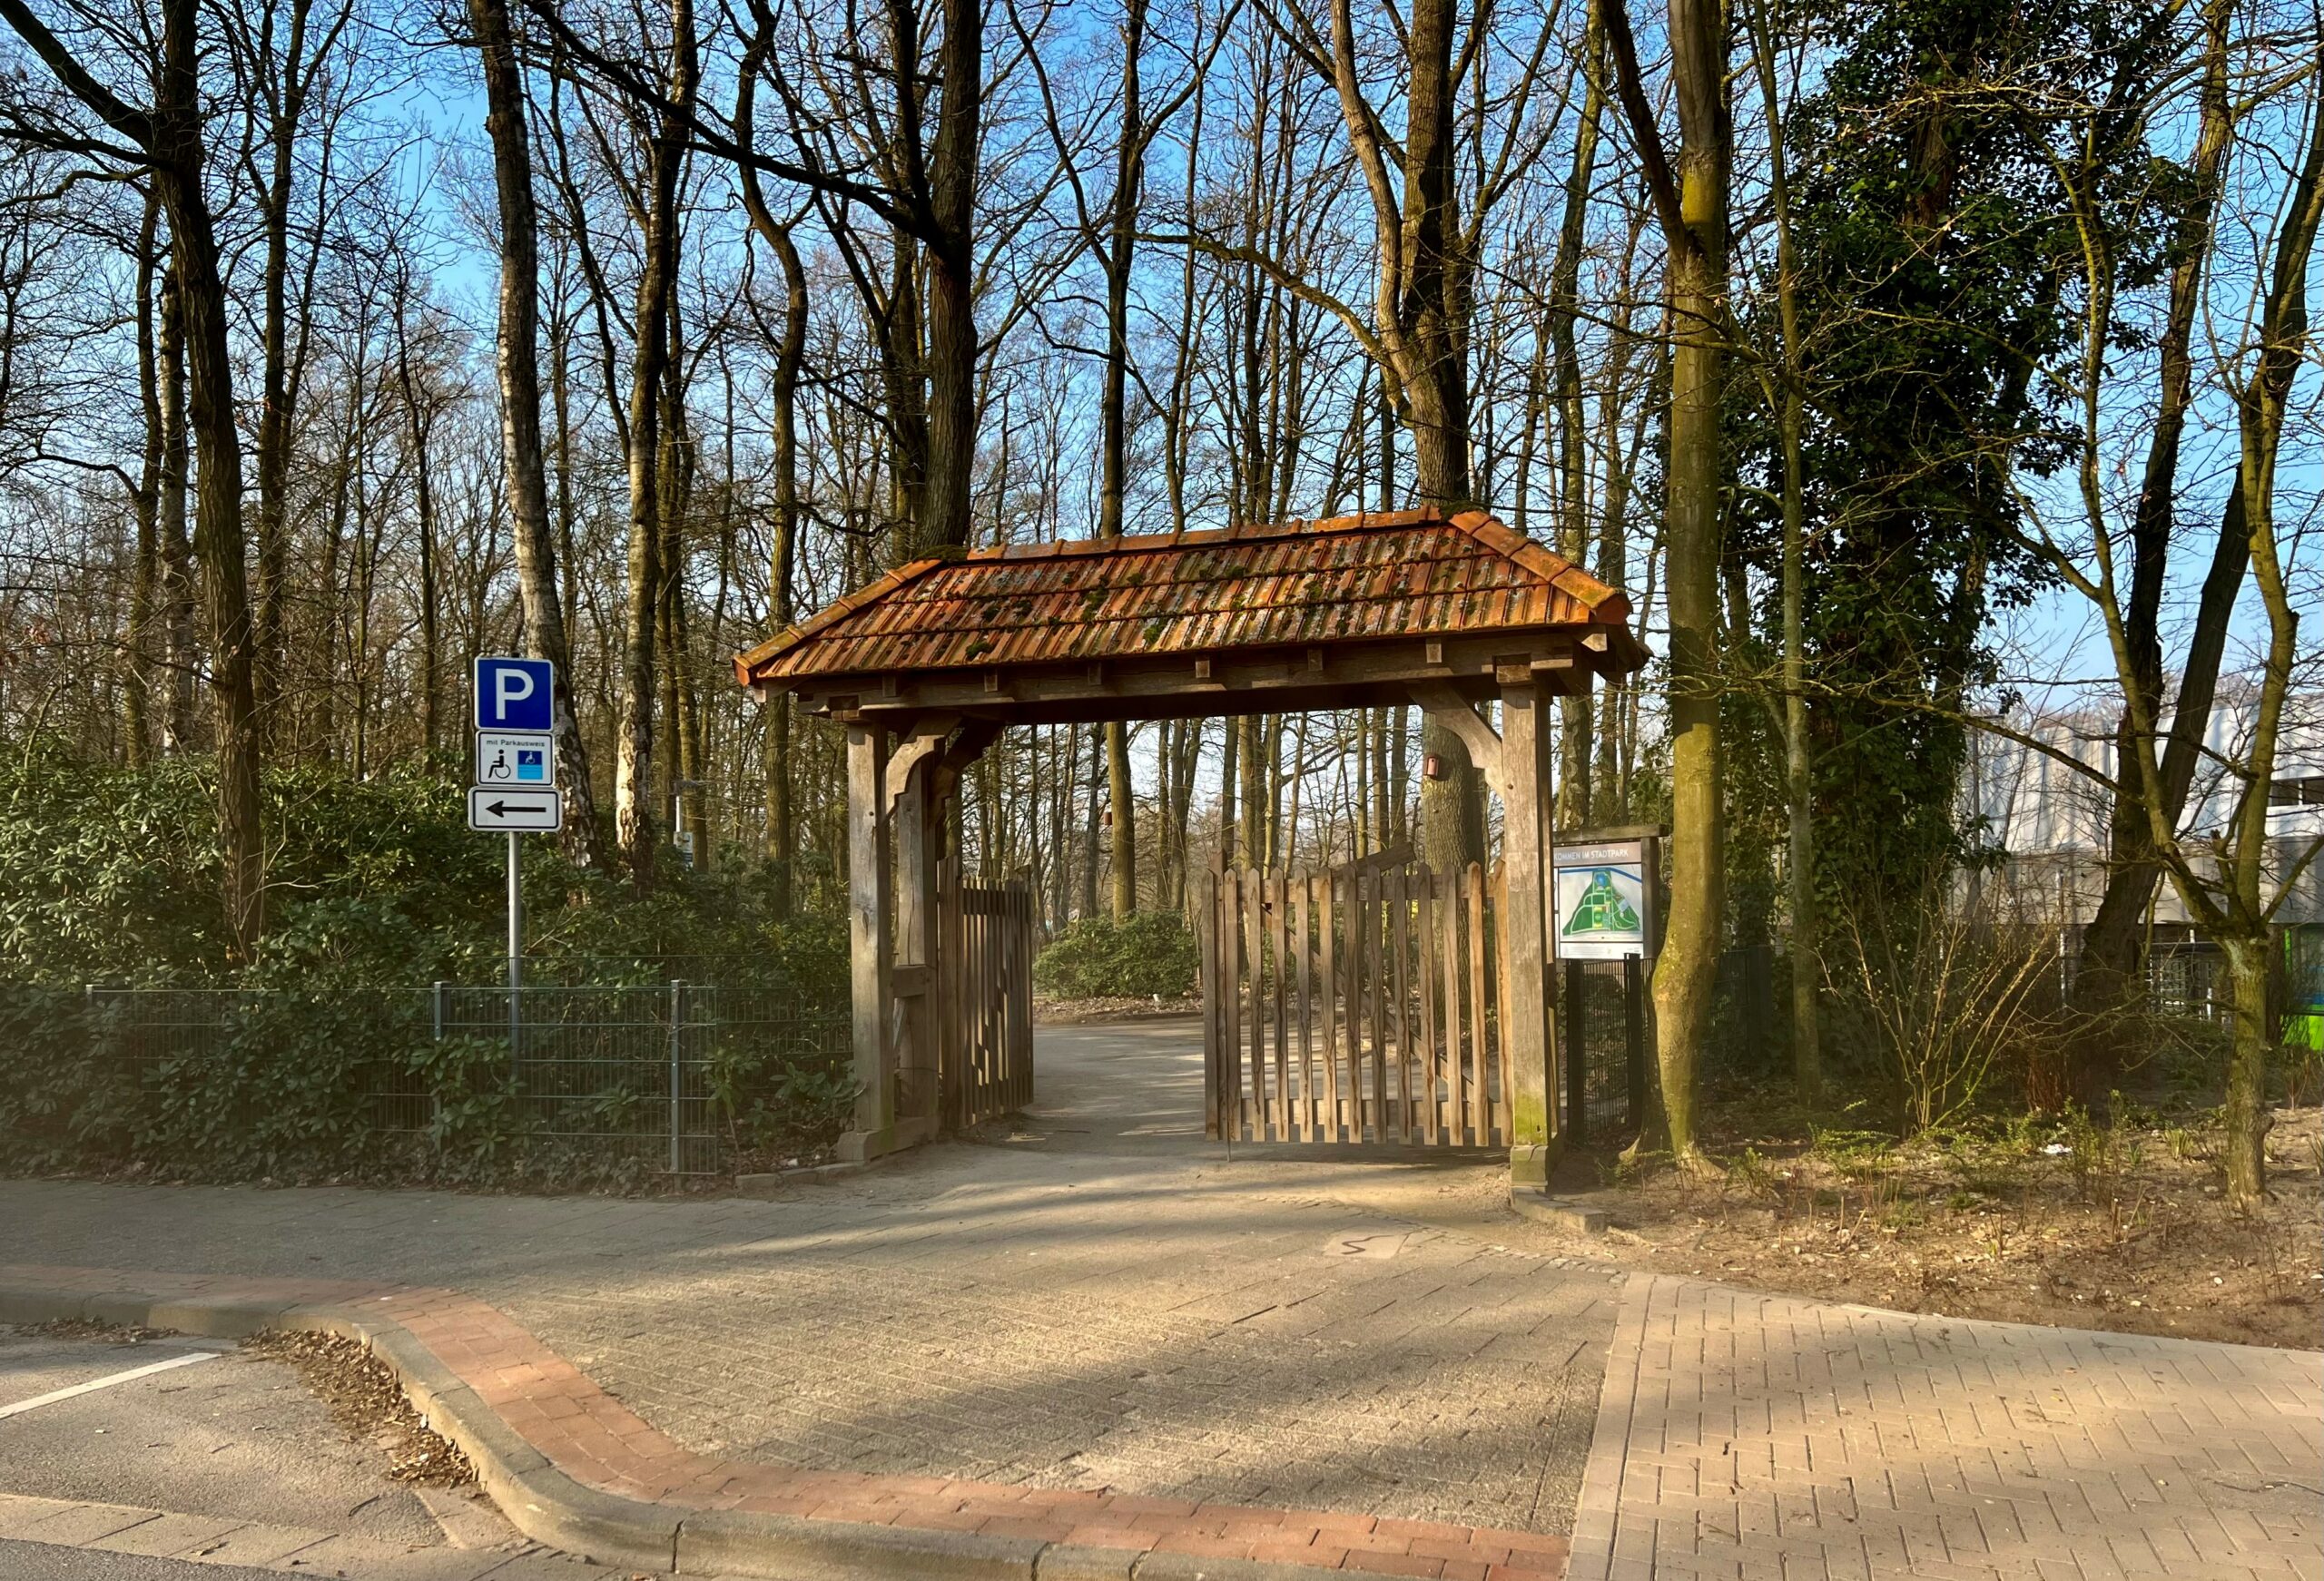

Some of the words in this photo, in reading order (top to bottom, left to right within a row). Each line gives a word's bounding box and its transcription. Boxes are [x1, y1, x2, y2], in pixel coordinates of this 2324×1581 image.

[496, 668, 534, 720] P
[500, 739, 545, 747] Parkausweis
[1581, 851, 1590, 859] IM
[1590, 849, 1629, 859] STADTPARK
